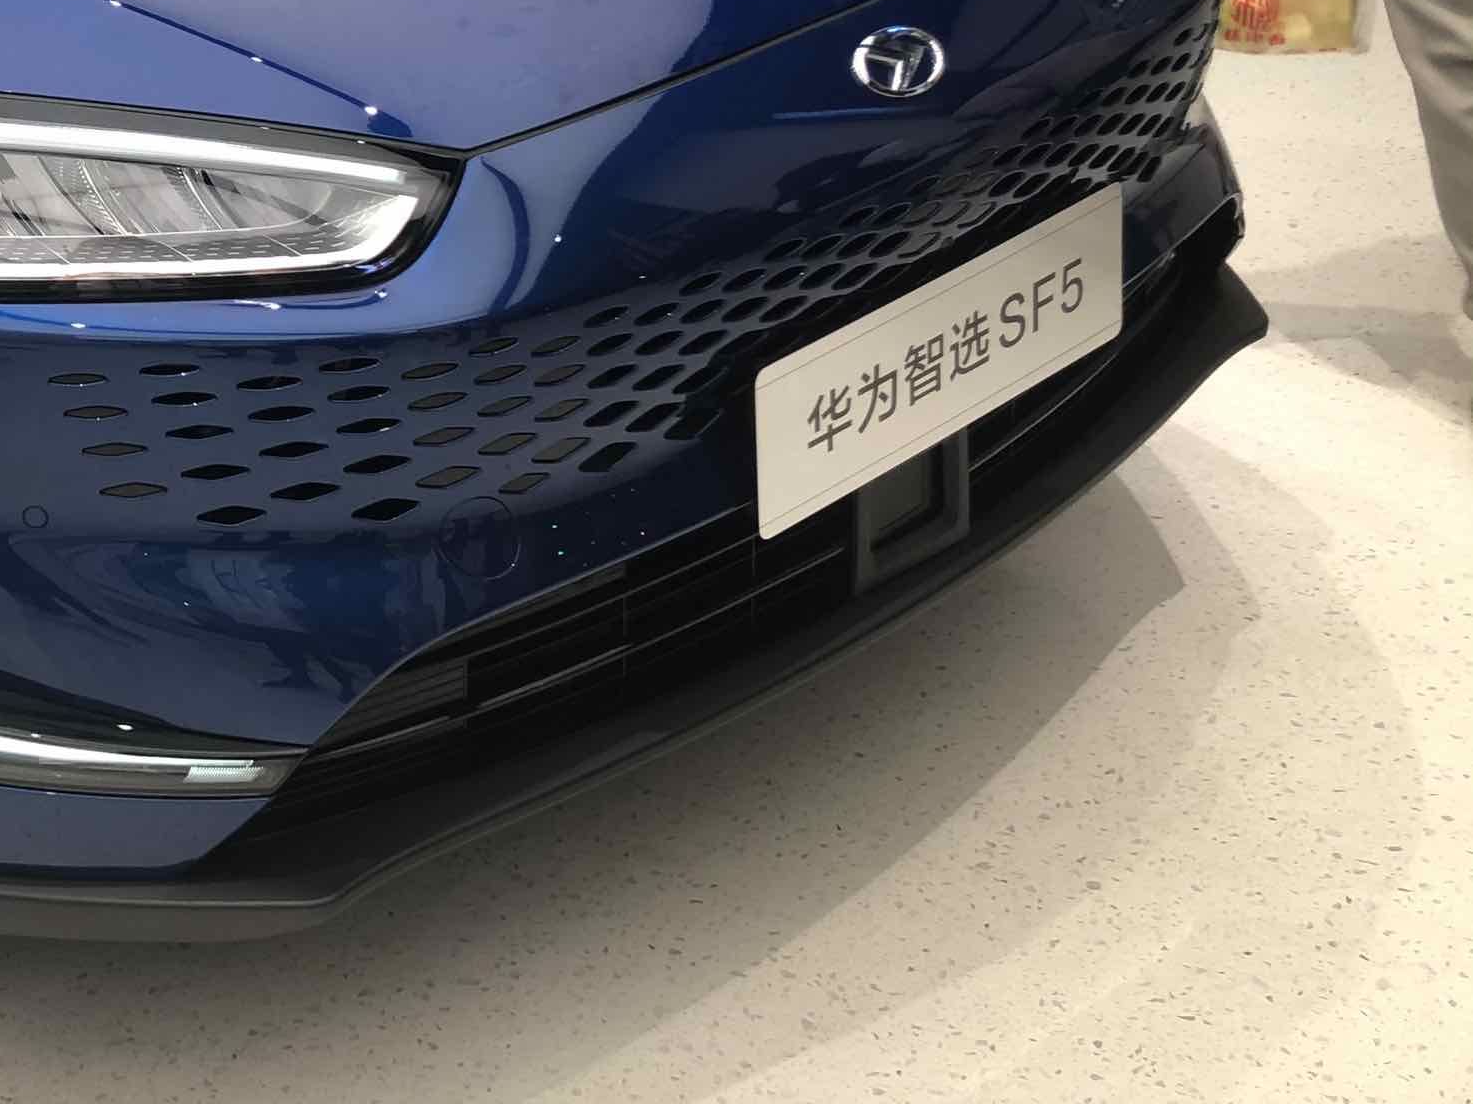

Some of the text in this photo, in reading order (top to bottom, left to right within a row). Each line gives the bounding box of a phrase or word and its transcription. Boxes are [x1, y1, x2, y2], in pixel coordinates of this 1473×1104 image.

[807, 258, 1084, 452] 华为智选 SF5
